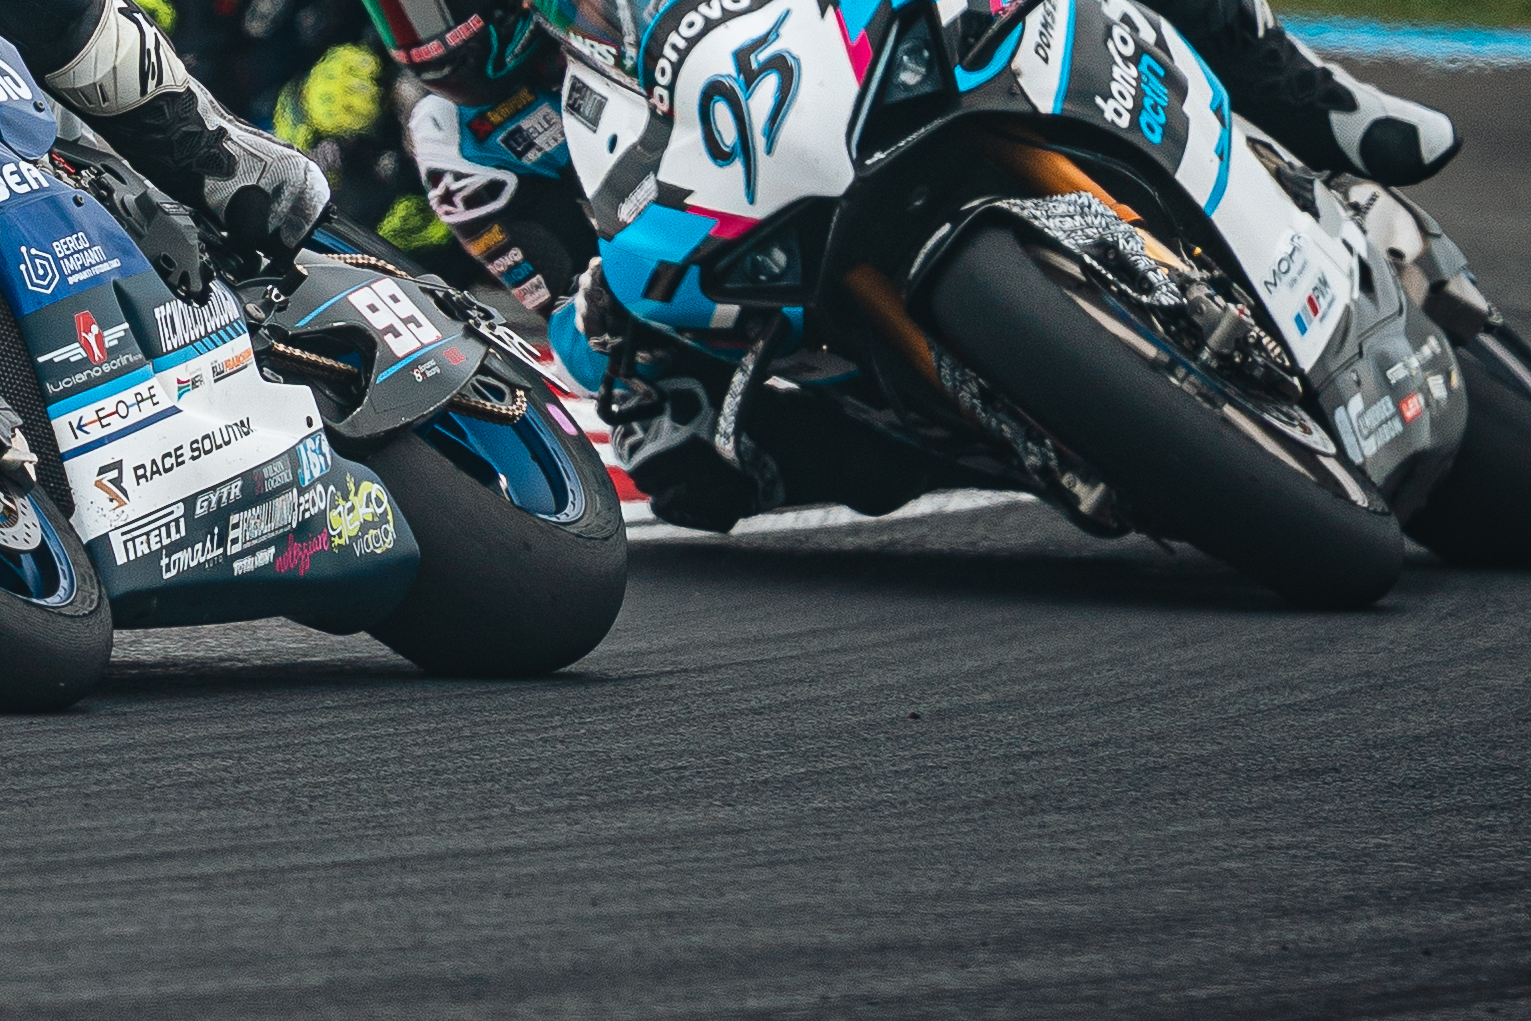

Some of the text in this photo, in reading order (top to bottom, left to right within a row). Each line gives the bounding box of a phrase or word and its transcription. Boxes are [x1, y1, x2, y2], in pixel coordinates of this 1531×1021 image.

[698, 8, 802, 205] 95
[52, 231, 91, 258] BERGO
[59, 245, 107, 276] IMPIANTI
[347, 277, 443, 359] 99
[68, 384, 160, 440] KEOPE
[132, 444, 186, 487] RACE
[194, 476, 243, 519] GYTR
[326, 482, 388, 545] GEKO
[108, 501, 186, 566] PIRELLI
[159, 526, 224, 580] tomasi
